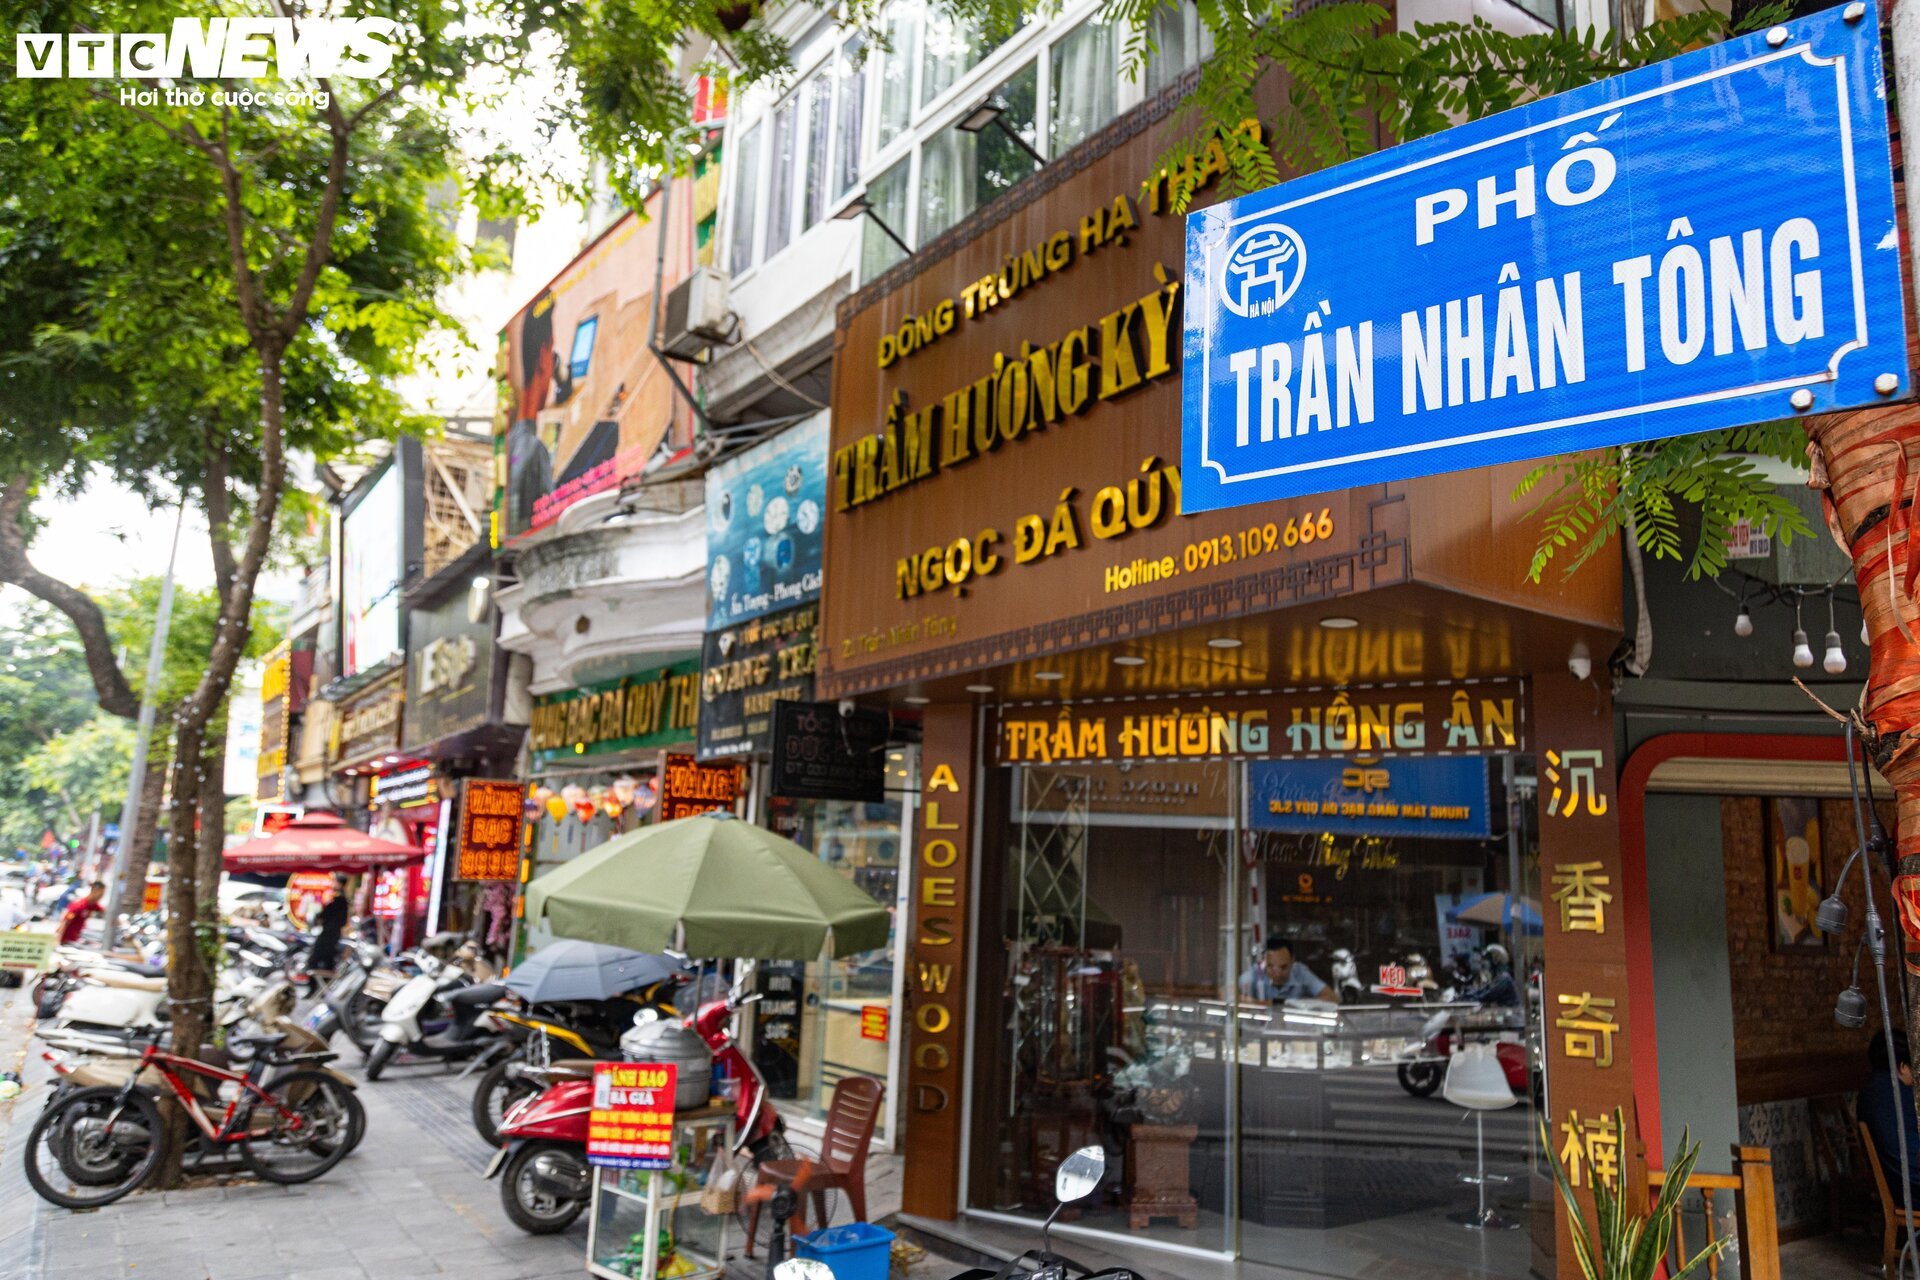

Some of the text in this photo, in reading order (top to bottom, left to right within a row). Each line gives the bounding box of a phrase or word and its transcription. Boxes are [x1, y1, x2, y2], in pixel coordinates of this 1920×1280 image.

[1416, 113, 1624, 245] PHỐ
[960, 229, 1072, 320] TRÙNG
[1080, 194, 1137, 255] HẠ
[834, 262, 1180, 513] TRẦM HƯƠNG KỲ
[1230, 217, 1824, 447] TRẦN NHÂN TÔNG
[896, 531, 1001, 599] NGỌC
[1013, 487, 1079, 564] ĐÁ
[1105, 553, 1180, 593] Hotline:
[1005, 690, 1518, 763] TRẦM HƯƠNG HỒNG ÂN
[914, 763, 960, 1113] ALOESWOOD
[1380, 962, 1405, 986] KÉO
[1546, 749, 1627, 1192] 沉香奇楠
[603, 1065, 637, 1087] ÁNH
